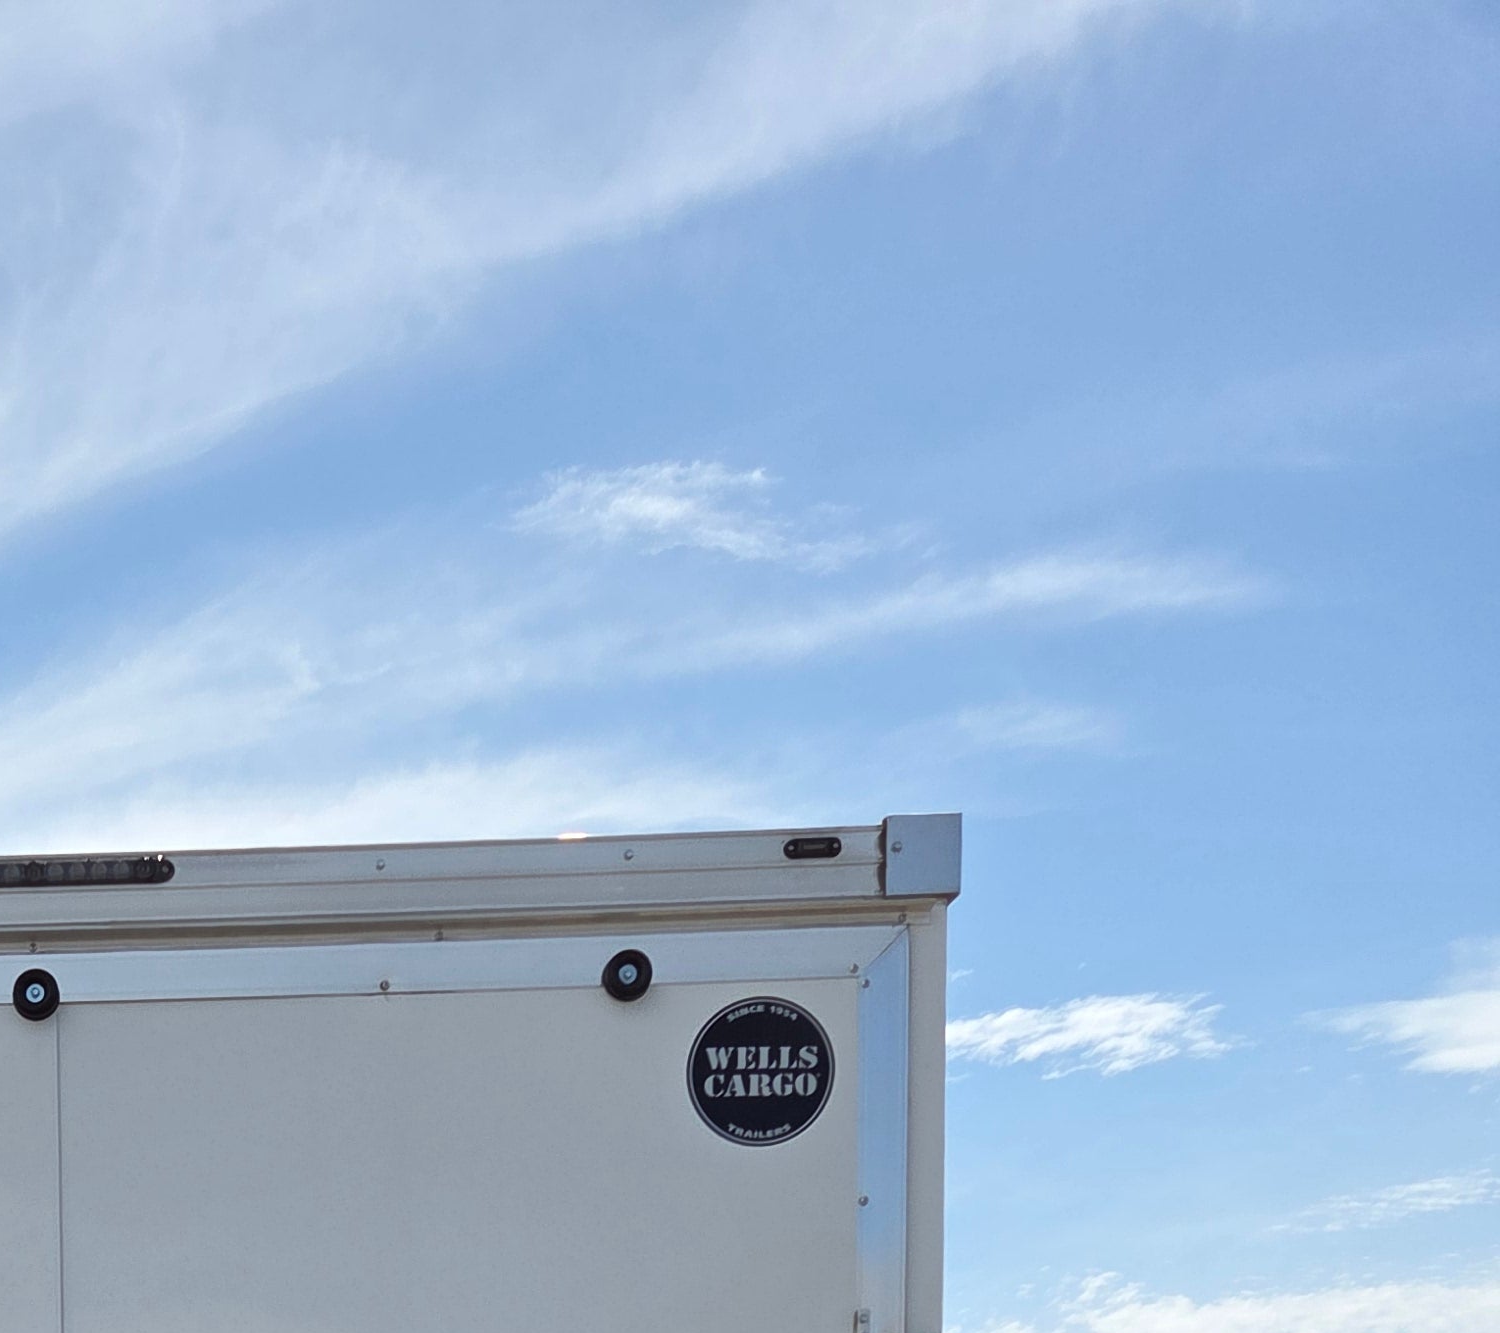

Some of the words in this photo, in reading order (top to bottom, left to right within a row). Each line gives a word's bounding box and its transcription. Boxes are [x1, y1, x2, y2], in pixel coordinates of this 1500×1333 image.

[726, 1004, 765, 1023] SINCE
[770, 1004, 798, 1021] 1954
[705, 1045, 819, 1071] WELLS
[703, 1072, 818, 1098] CARGO
[727, 1123, 792, 1139] TRAILERS
